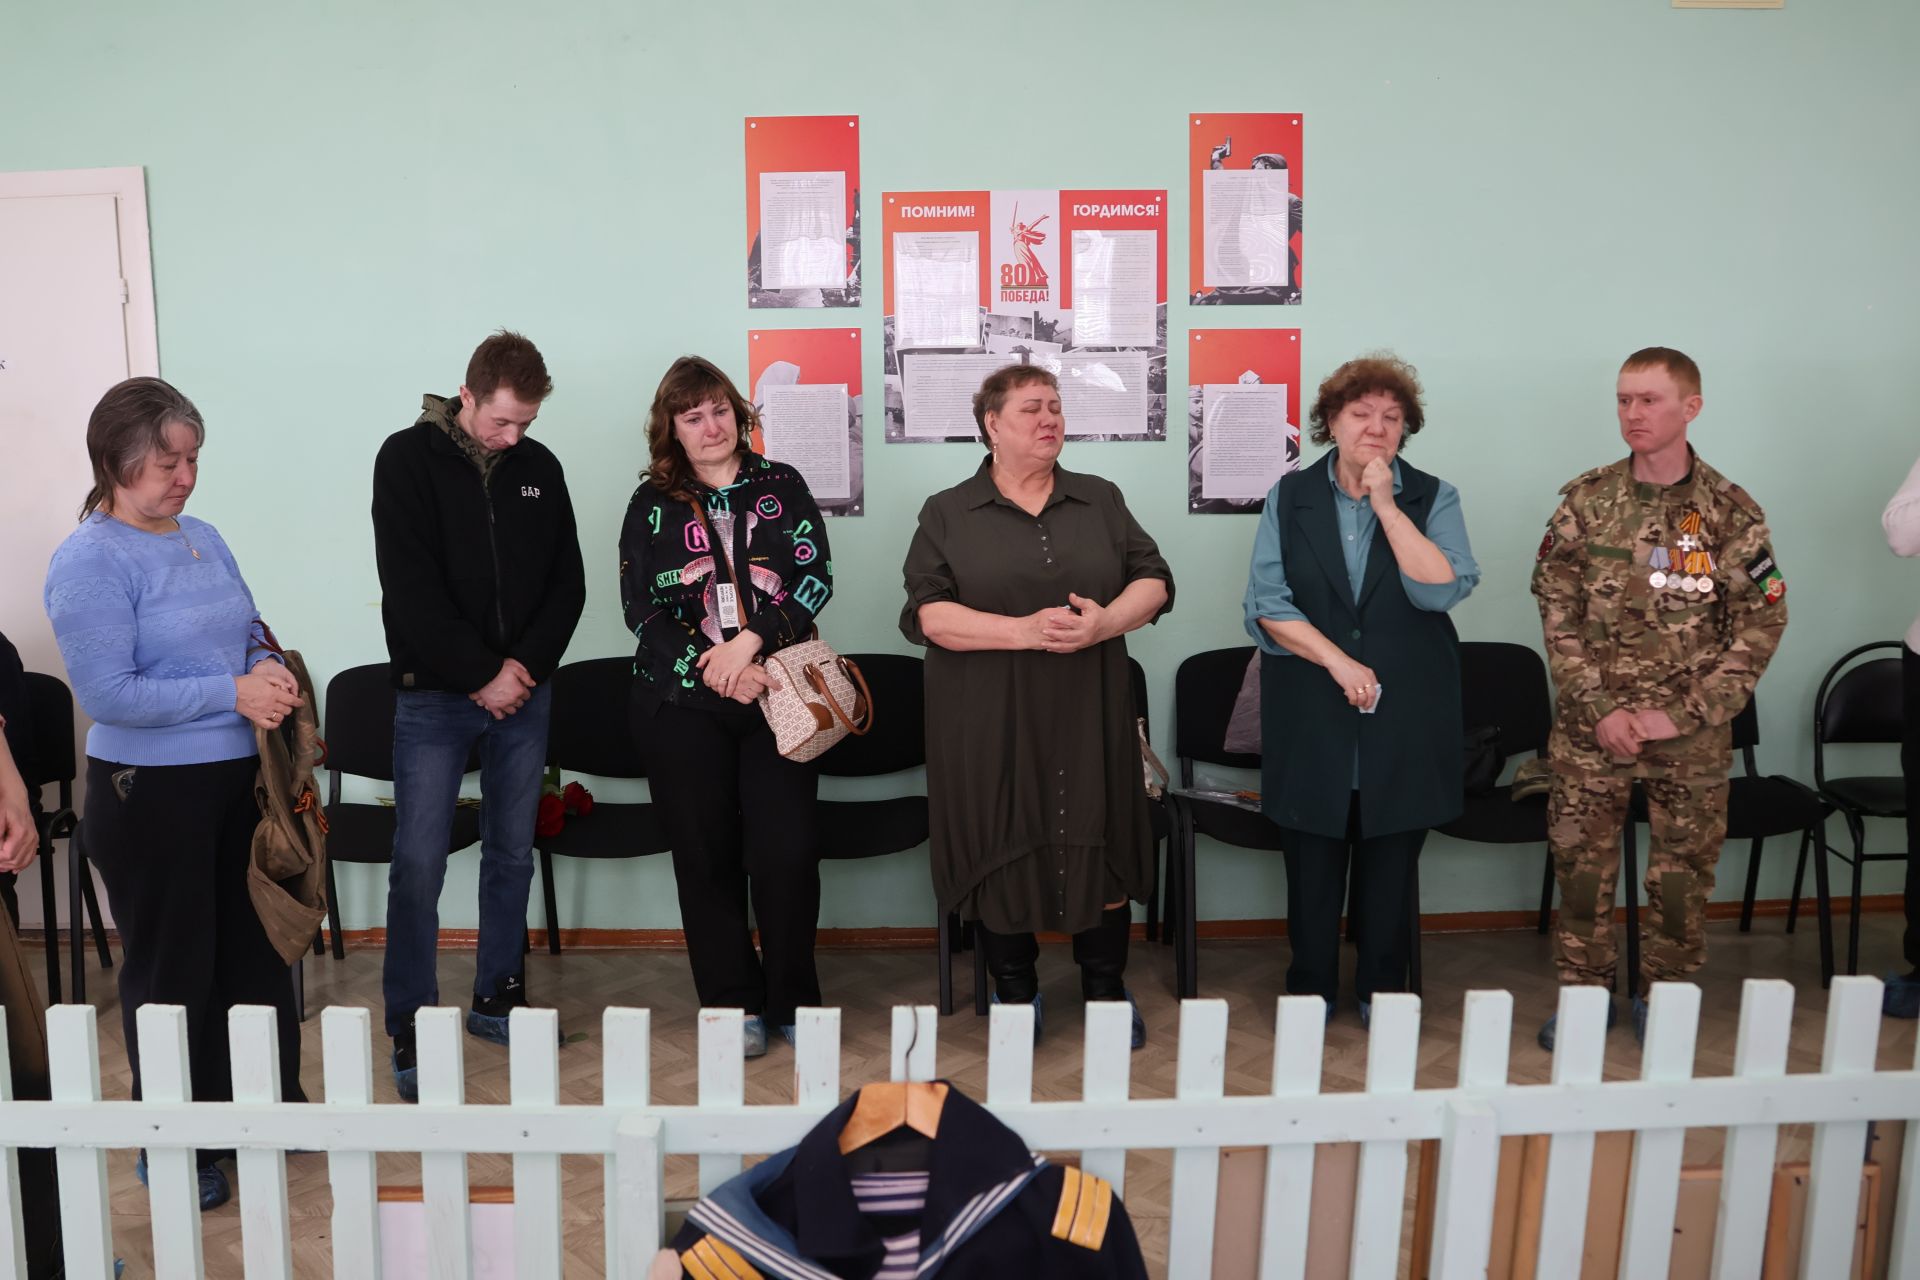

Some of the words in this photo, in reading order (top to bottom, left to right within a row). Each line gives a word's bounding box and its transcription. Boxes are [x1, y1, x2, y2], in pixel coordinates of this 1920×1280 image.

[901, 206, 975, 218] ПОМНИМ!
[1073, 204, 1160, 218] ГОРДИМСЯ!
[1001, 263, 1027, 286] 80
[1001, 290, 1049, 304] ПОБЕДА!
[521, 486, 540, 498] GAP
